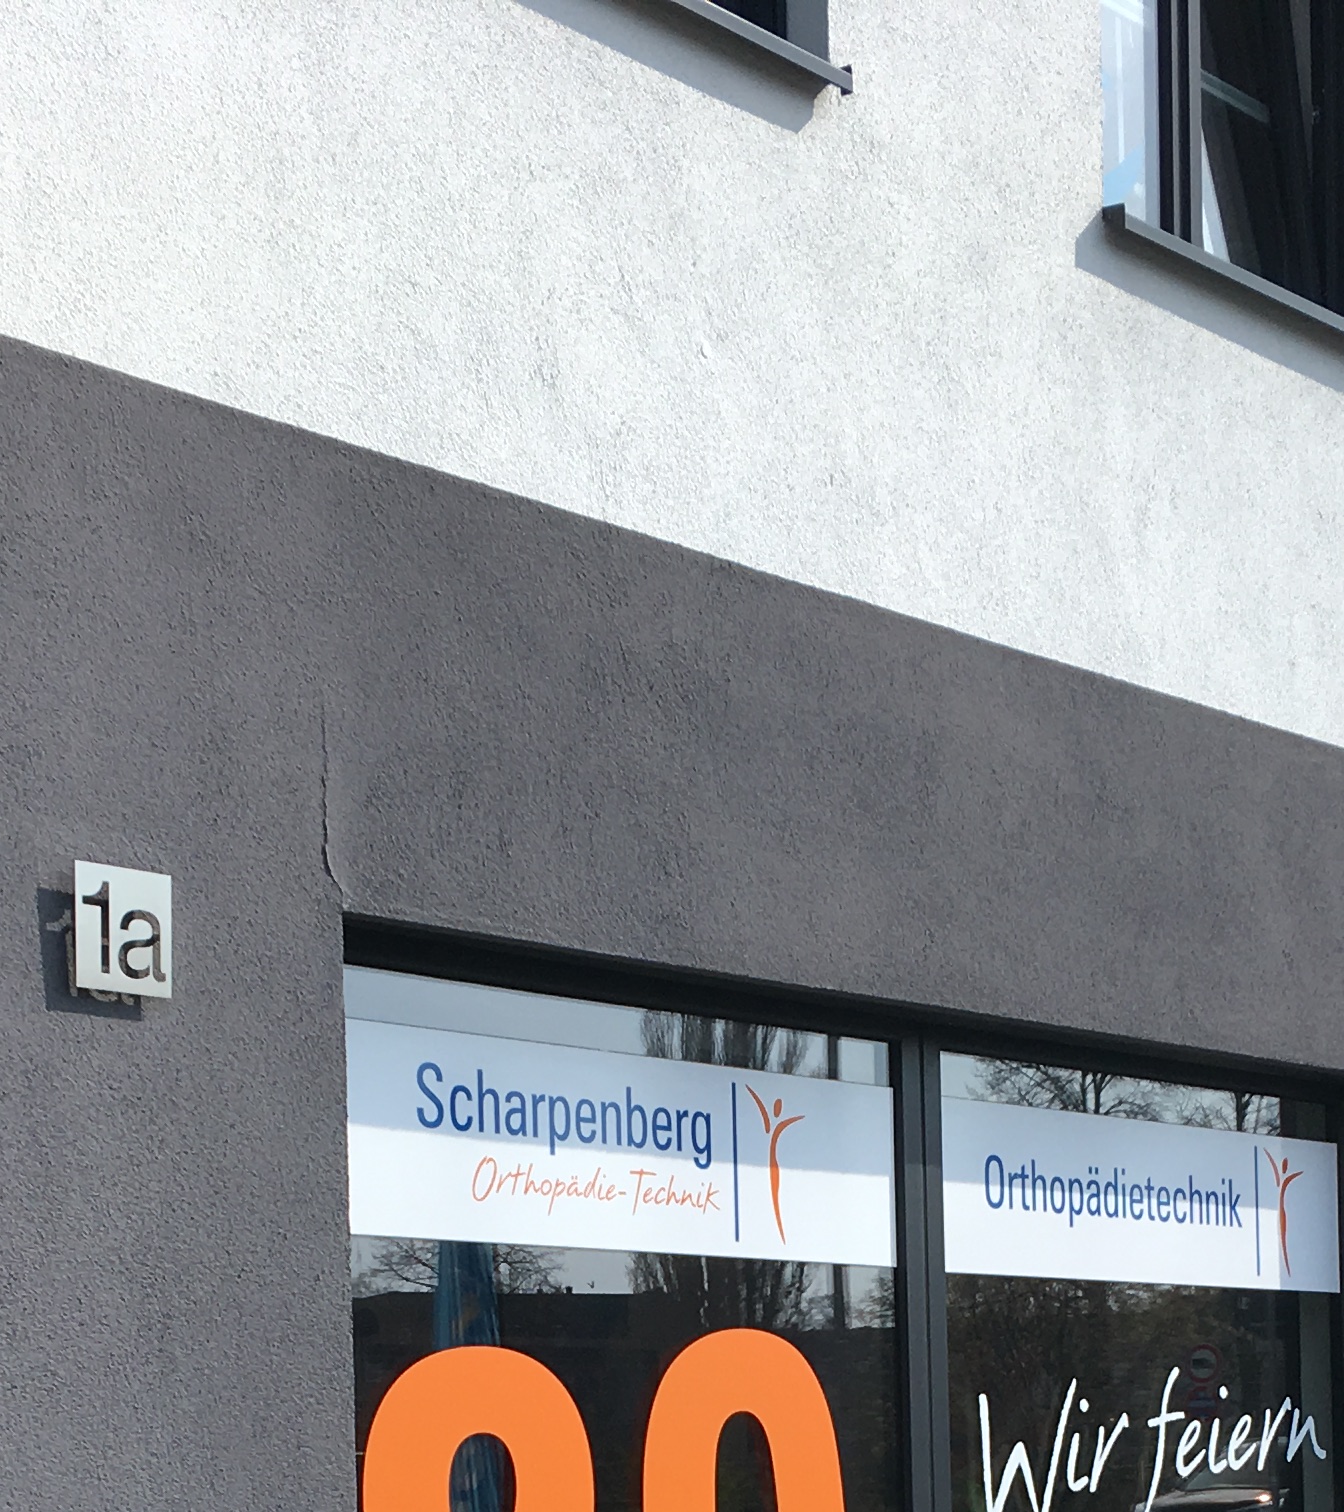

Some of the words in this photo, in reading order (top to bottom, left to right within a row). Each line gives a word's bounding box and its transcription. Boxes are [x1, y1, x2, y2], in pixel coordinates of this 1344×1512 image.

[82, 881, 167, 983] 1a
[415, 1061, 713, 1169] Scharpenberg
[471, 1154, 722, 1217] Orthopädie-Technik
[984, 1152, 1243, 1229] Orthopädietechnik
